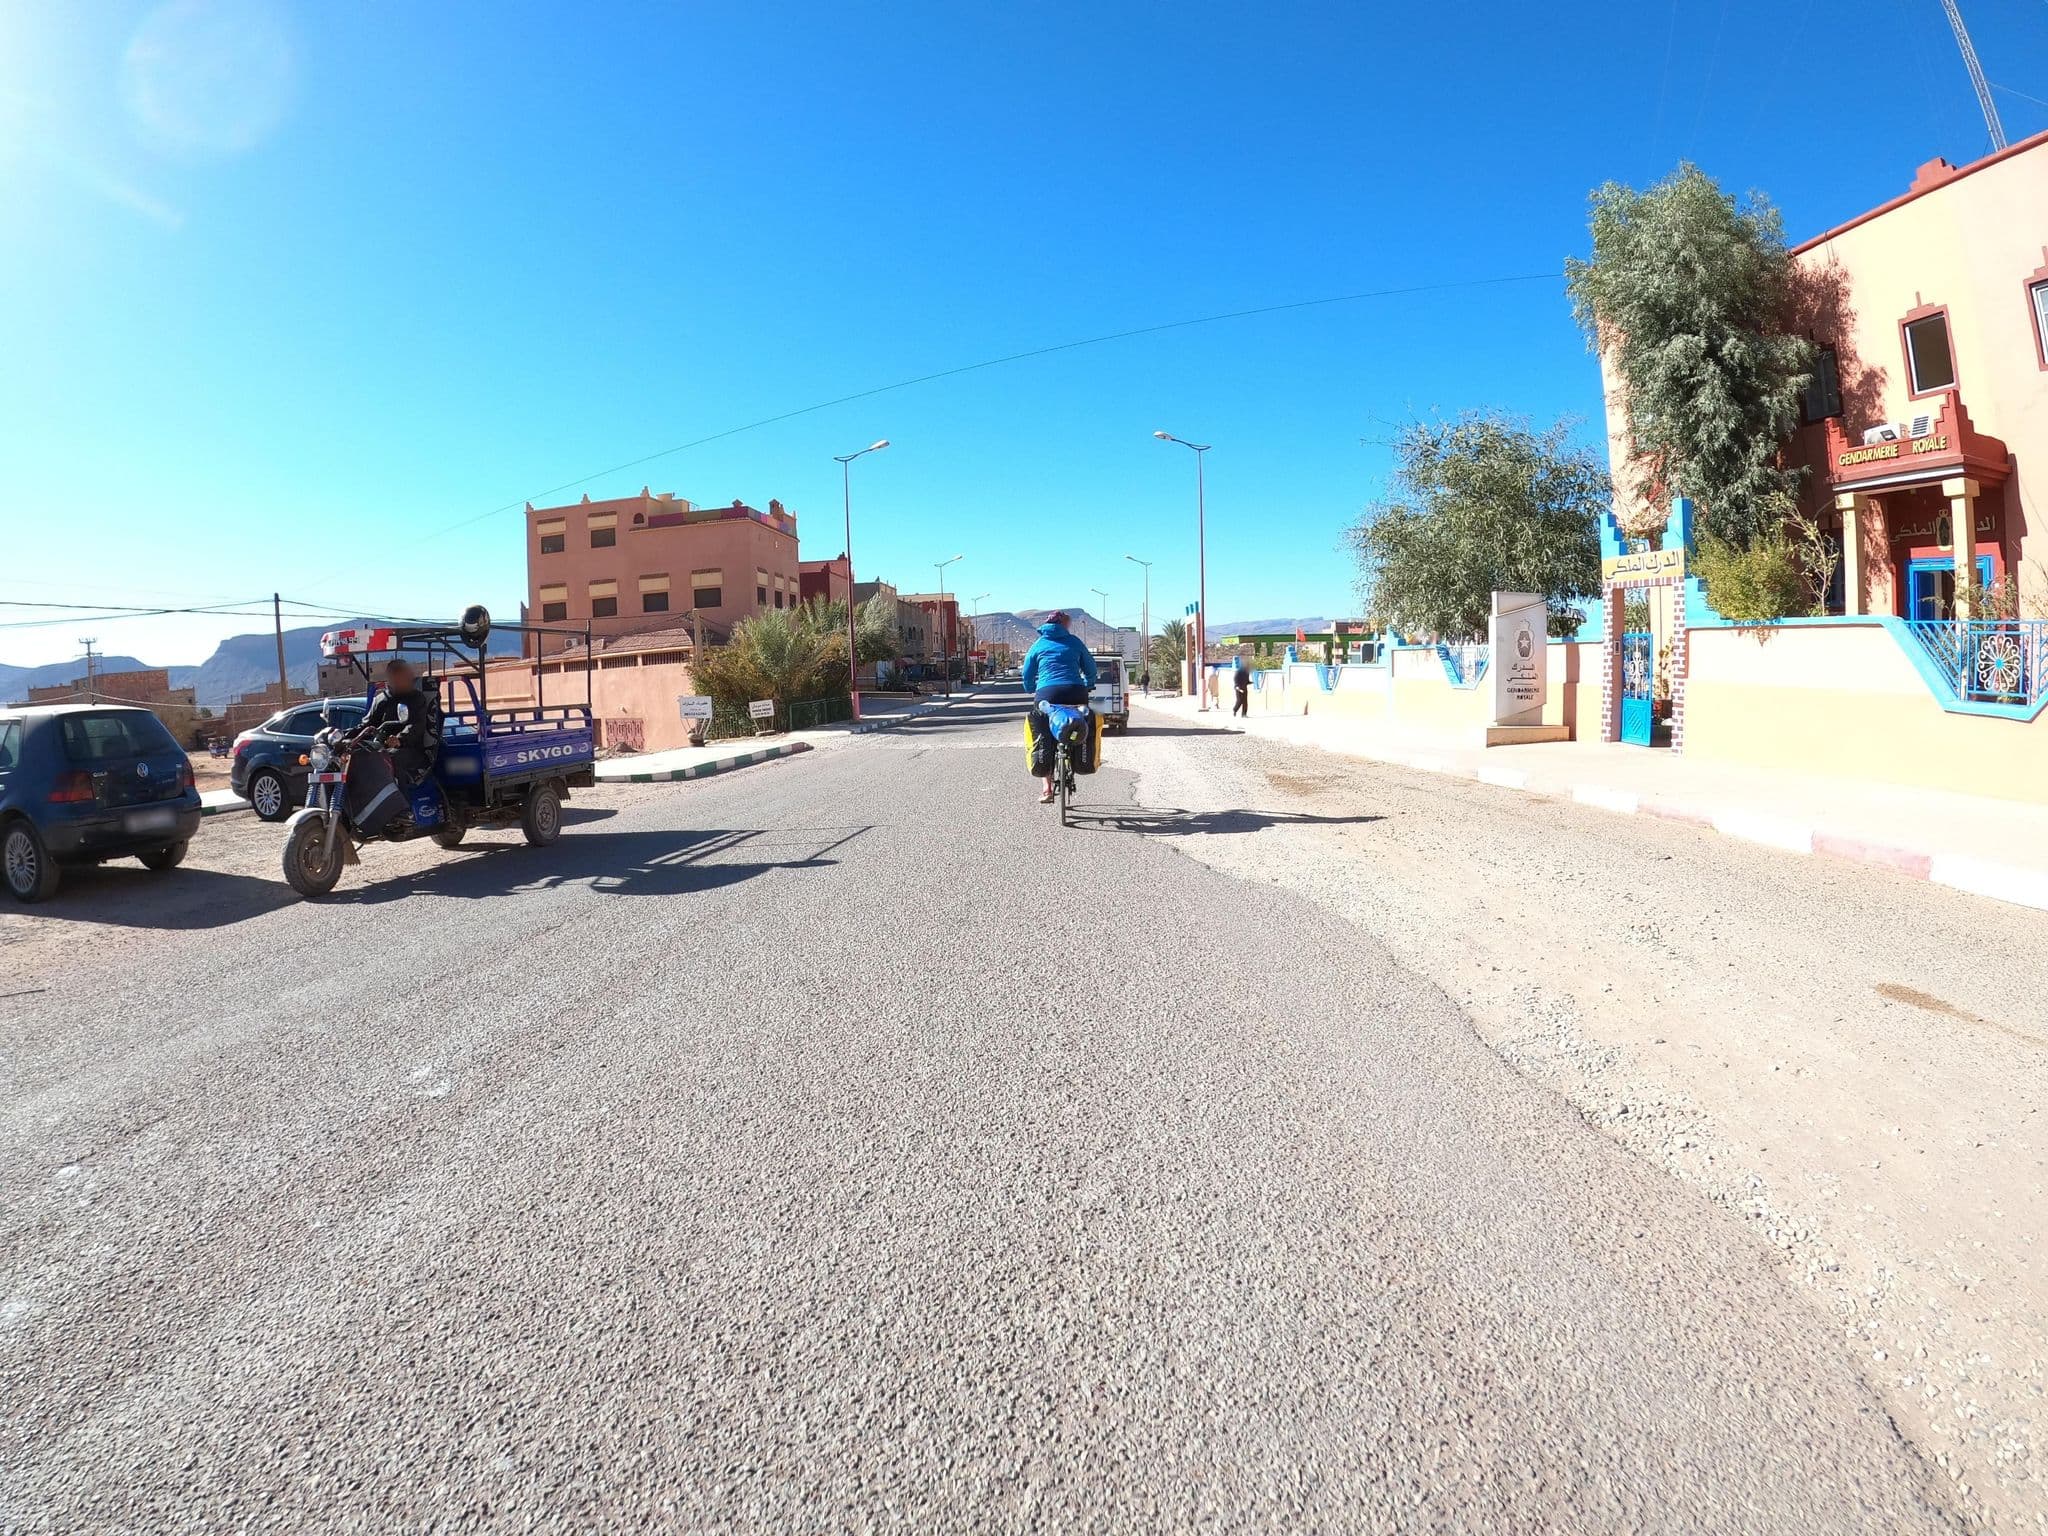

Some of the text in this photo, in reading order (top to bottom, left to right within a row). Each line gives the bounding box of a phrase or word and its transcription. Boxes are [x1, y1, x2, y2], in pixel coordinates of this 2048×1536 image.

[1839, 436, 1947, 466] GENDARMERIE ROYALE
[1645, 550, 1680, 574] الدرك
[517, 744, 573, 764] SKYGO
